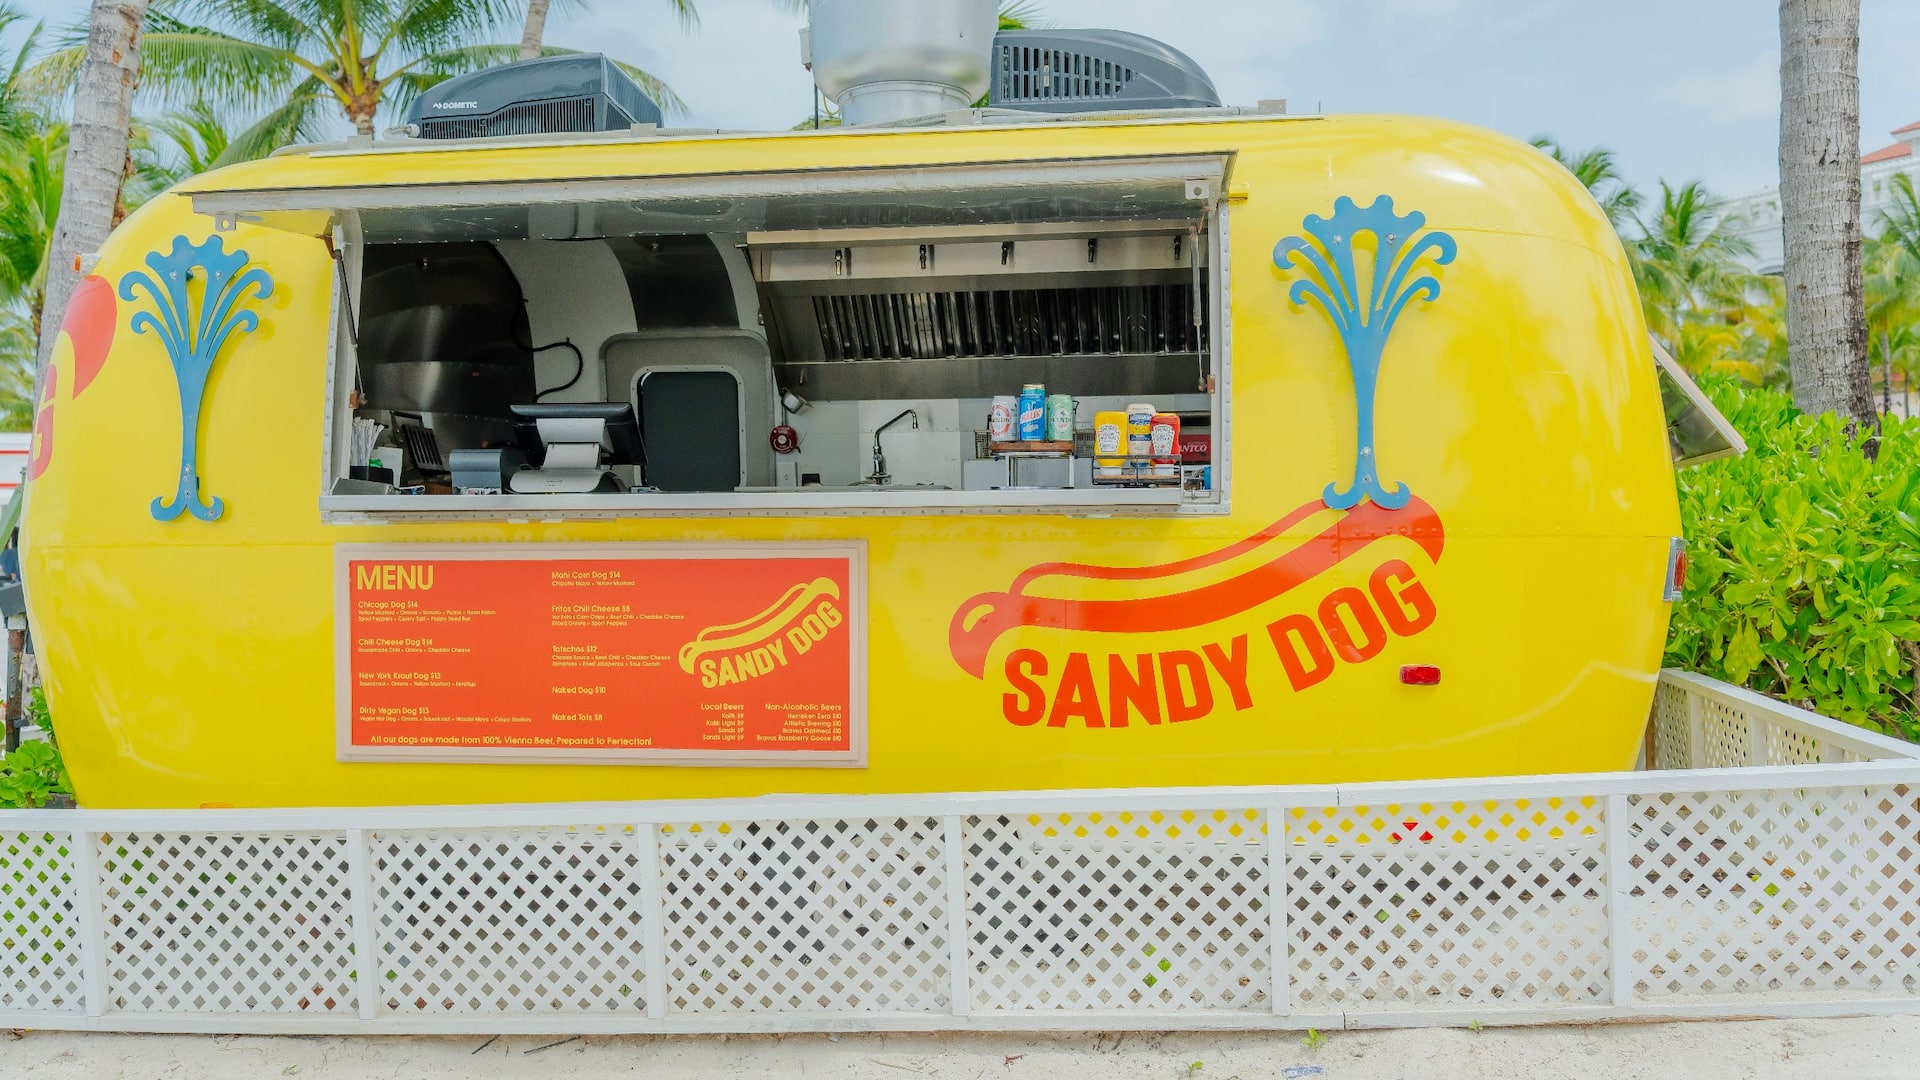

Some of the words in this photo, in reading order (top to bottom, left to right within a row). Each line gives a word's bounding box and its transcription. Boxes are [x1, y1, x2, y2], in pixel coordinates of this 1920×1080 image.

[443, 101, 478, 109] DOMETIC
[357, 565, 433, 590] MENU
[552, 571, 570, 579] Mahi
[572, 571, 590, 579] Corn
[592, 571, 607, 580] Dog
[358, 601, 389, 609] Chicago
[391, 601, 405, 609] Dog
[405, 638, 420, 647] Dog
[422, 638, 432, 646] $14
[700, 638, 788, 688] SANDY
[786, 600, 843, 655] DOG
[1002, 633, 1255, 728] SANDY
[1266, 558, 1437, 693] DOG
[413, 672, 429, 681] Dog
[578, 687, 593, 695] Dog
[595, 686, 606, 694] $10
[360, 707, 376, 715] Dirty
[378, 707, 401, 716] Vegan
[402, 707, 417, 715] Dog
[398, 736, 418, 744] dogs
[483, 736, 502, 744] 100%
[504, 736, 532, 744] Vienna
[557, 737, 594, 746] Prepared
[607, 737, 651, 745] Perfection!
